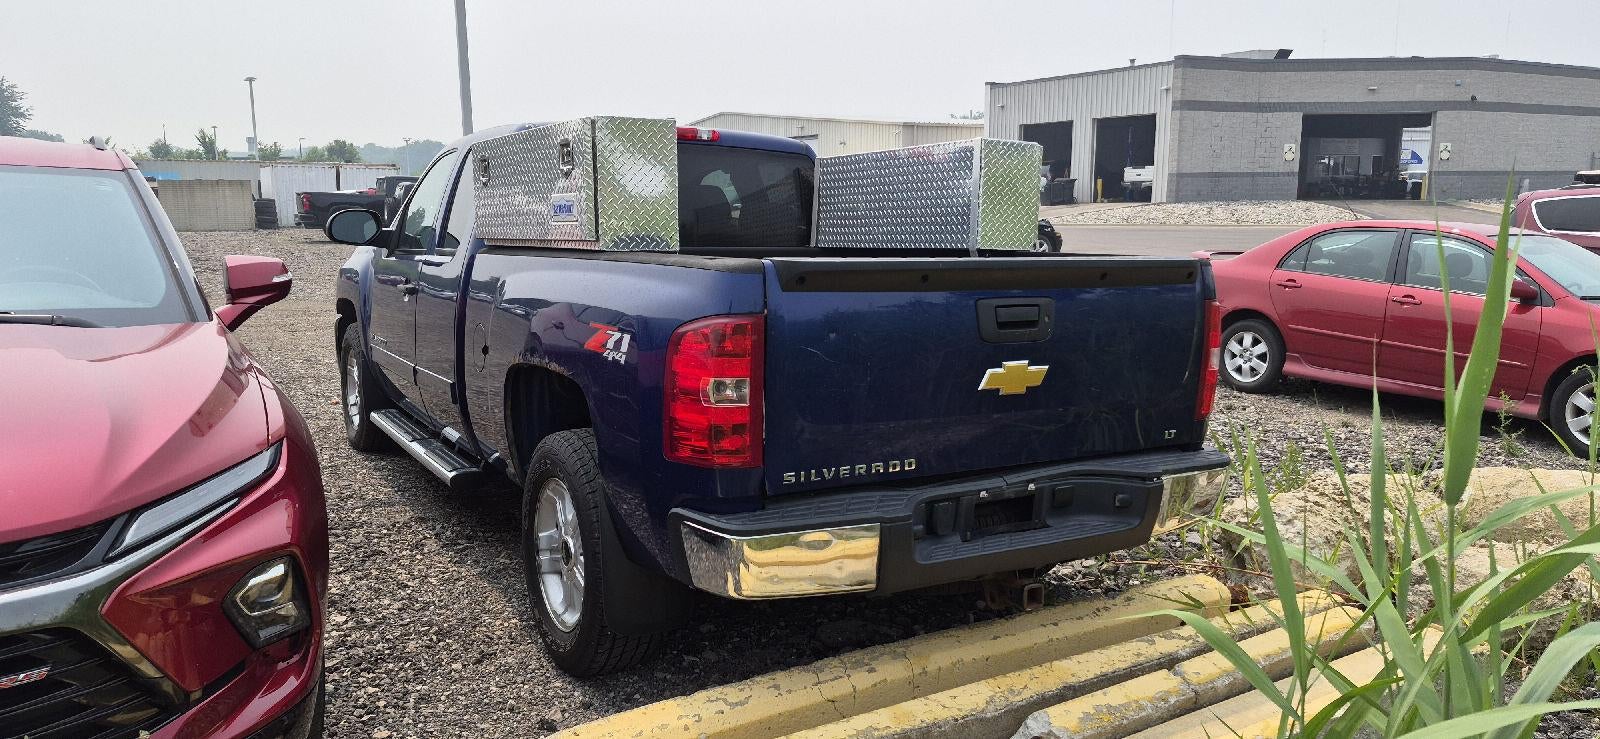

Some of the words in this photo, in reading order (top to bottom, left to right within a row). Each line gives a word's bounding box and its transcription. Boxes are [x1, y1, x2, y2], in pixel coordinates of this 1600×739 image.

[584, 322, 631, 353] Z71
[1164, 429, 1177, 440] LT
[782, 458, 917, 485] SILVERADO
